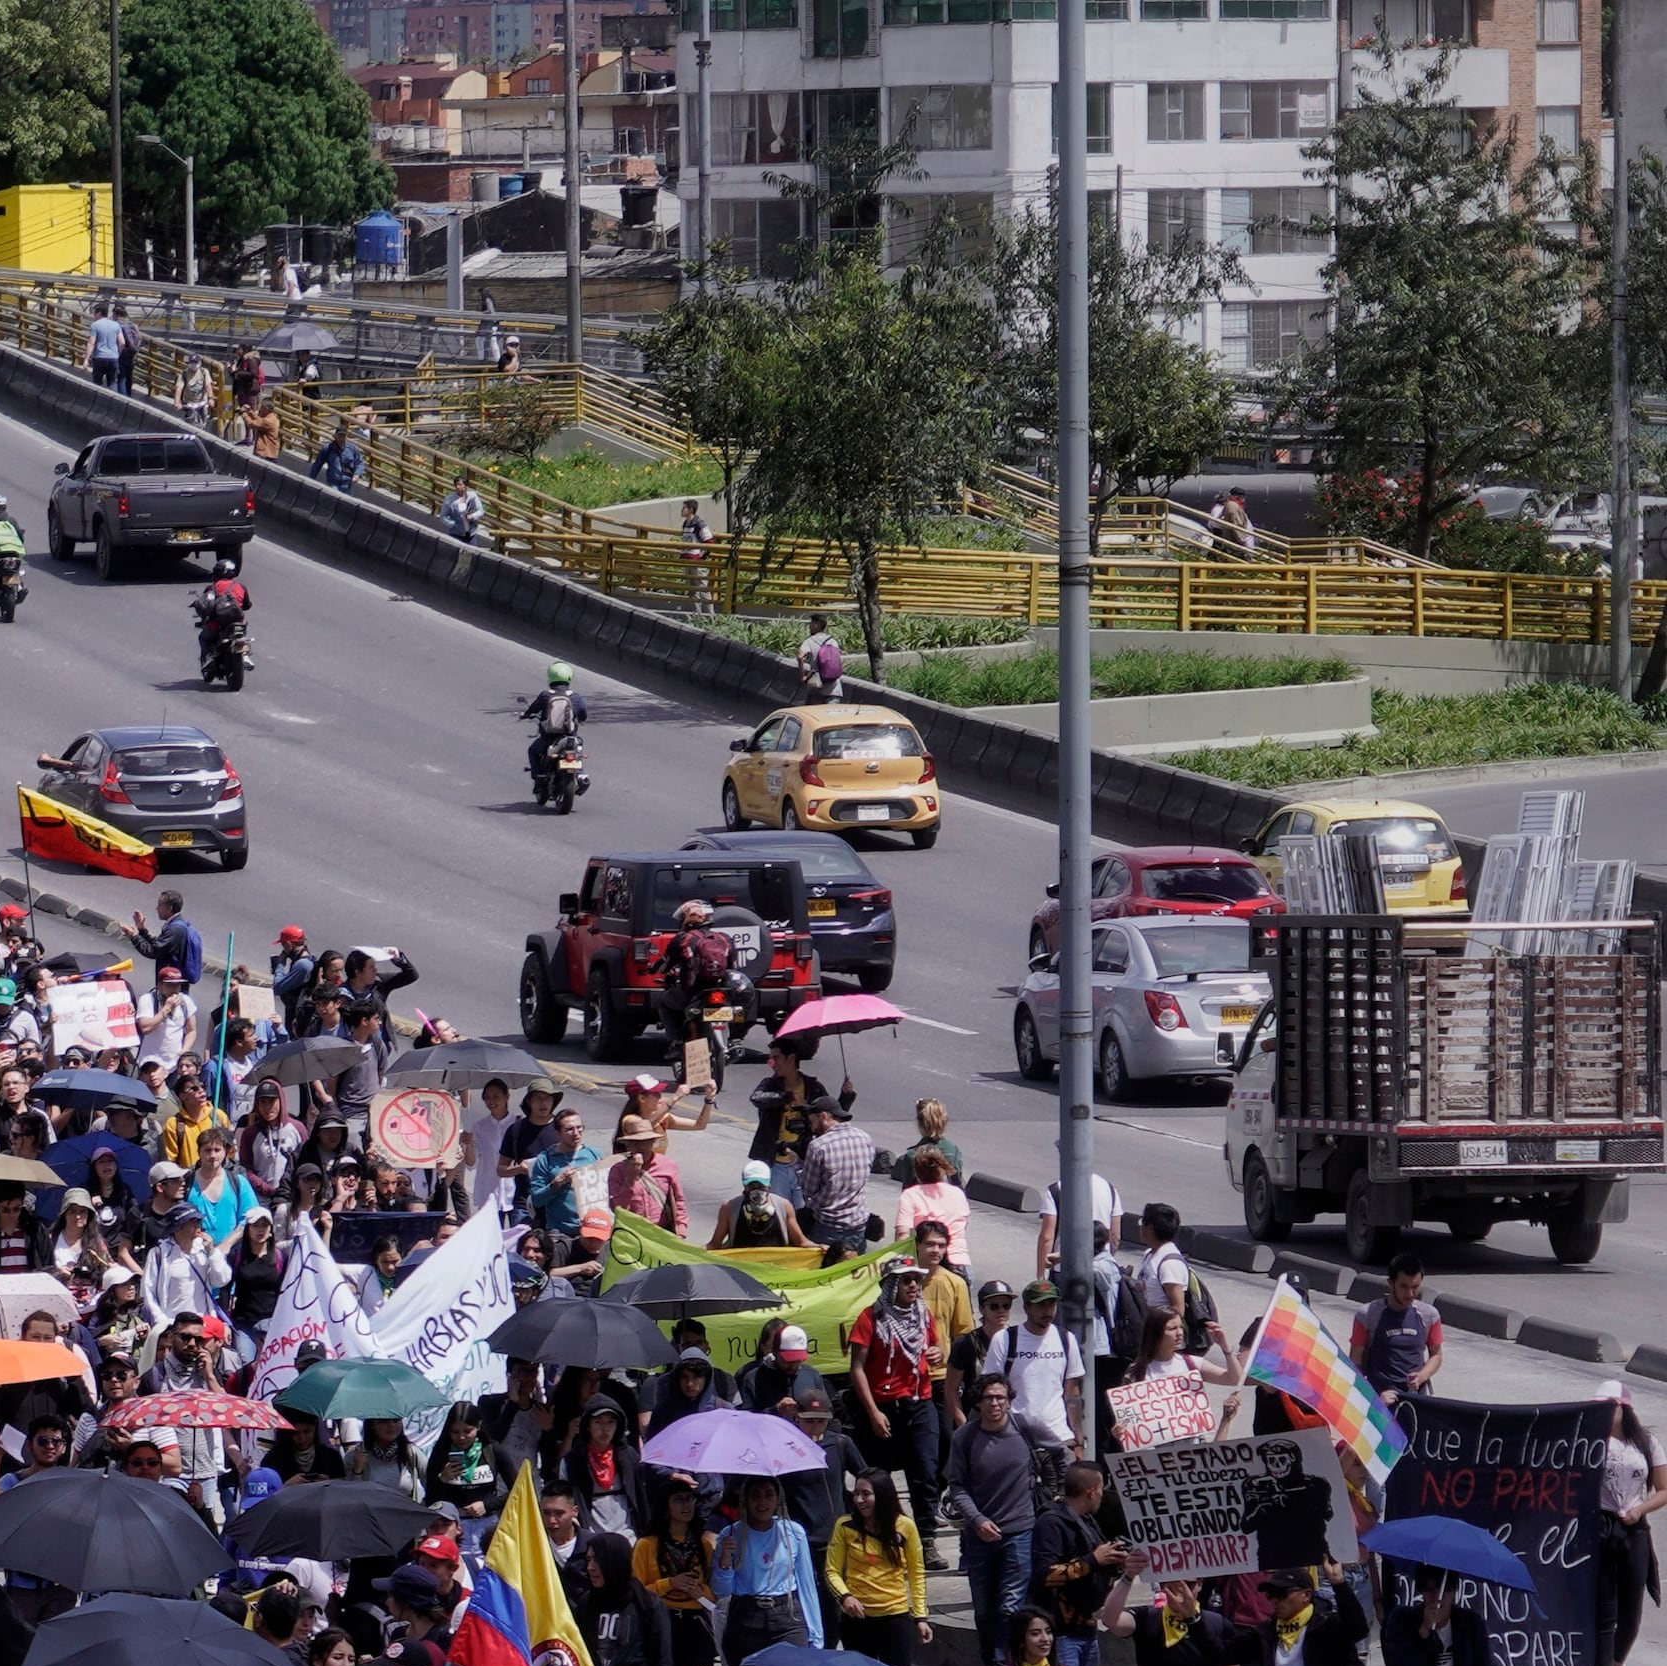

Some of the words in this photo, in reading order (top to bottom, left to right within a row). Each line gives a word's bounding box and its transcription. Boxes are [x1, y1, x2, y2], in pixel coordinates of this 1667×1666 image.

[1462, 1143, 1506, 1161] USA-544
[1111, 1371, 1204, 1405] SICARIOS
[1140, 1392, 1210, 1423] ESTADO
[1476, 1409, 1503, 1465] la
[1521, 1408, 1606, 1469] lucha
[1161, 1442, 1254, 1472] ESTADO
[1130, 1493, 1169, 1517] TE
[1421, 1470, 1475, 1507] NO
[1494, 1470, 1582, 1515] PARE
[1130, 1507, 1241, 1545] OBLIGANDO
[1539, 1517, 1591, 1569] el
[1148, 1534, 1249, 1574] DISPARAR?
